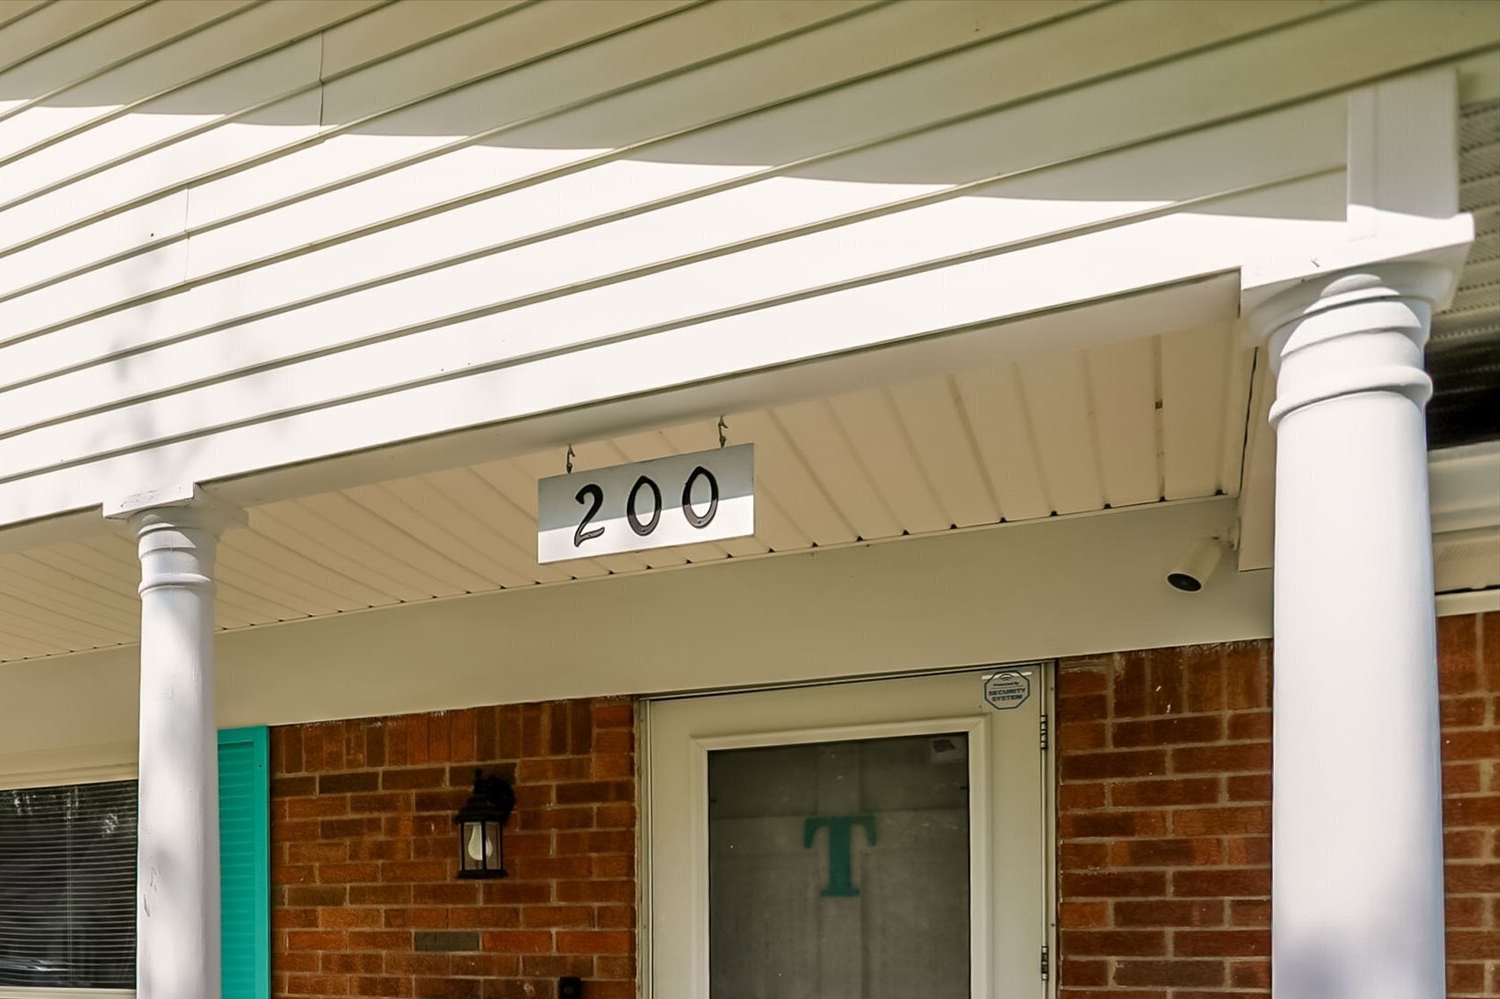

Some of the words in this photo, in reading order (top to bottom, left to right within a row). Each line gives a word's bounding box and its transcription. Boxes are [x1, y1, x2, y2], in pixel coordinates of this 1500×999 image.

[574, 466, 719, 548] 200
[988, 687, 1026, 696] SECURITY
[803, 815, 877, 898] T
